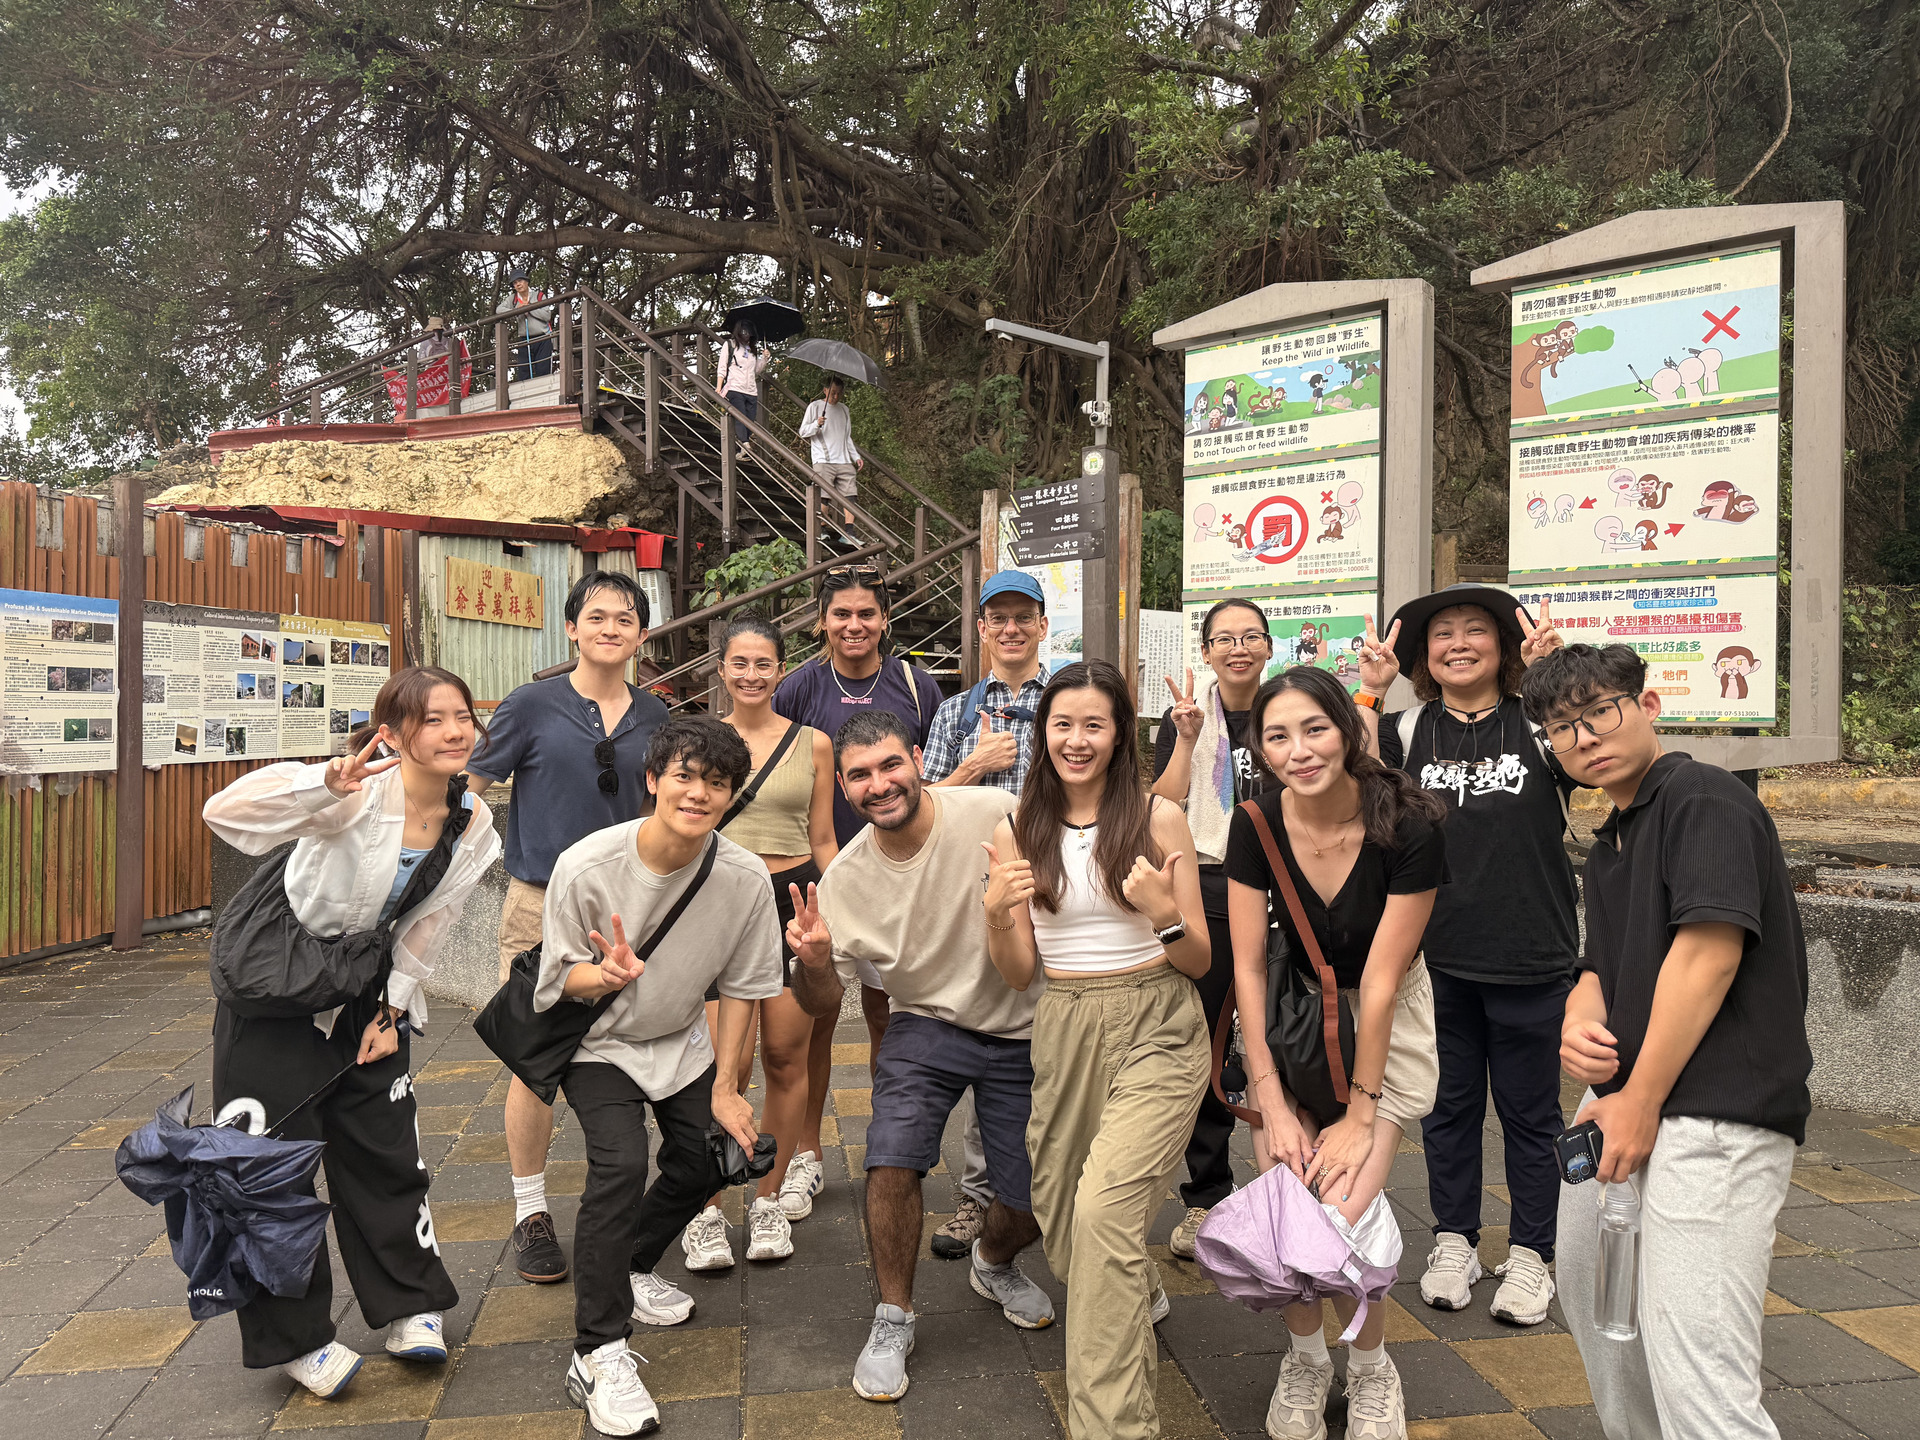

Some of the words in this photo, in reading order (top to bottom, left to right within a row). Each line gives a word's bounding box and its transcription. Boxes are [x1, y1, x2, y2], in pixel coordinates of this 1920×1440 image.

[1522, 287, 1617, 312] 請勿傷害野生動物
[1262, 357, 1284, 366] Keep
[1285, 353, 1299, 362] the
[1326, 346, 1334, 354] in
[1336, 341, 1370, 352] Wildlife
[1193, 423, 1309, 449] 請勿接觸或餵食野生動物
[1221, 445, 1246, 455] Touch
[1258, 440, 1276, 449] feed
[1278, 436, 1308, 446] wildlife
[1519, 423, 1756, 459] 接觸或餵食野生動物會增加疾病傳染的機率
[1212, 469, 1346, 494] 接觸或餵食野生動物是違法行為
[4, 602, 24, 610] Profuse
[41, 606, 70, 614] Sustainable
[71, 608, 87, 616] Marine
[87, 610, 117, 618] Development
[194, 1288, 223, 1297] HOLIC
